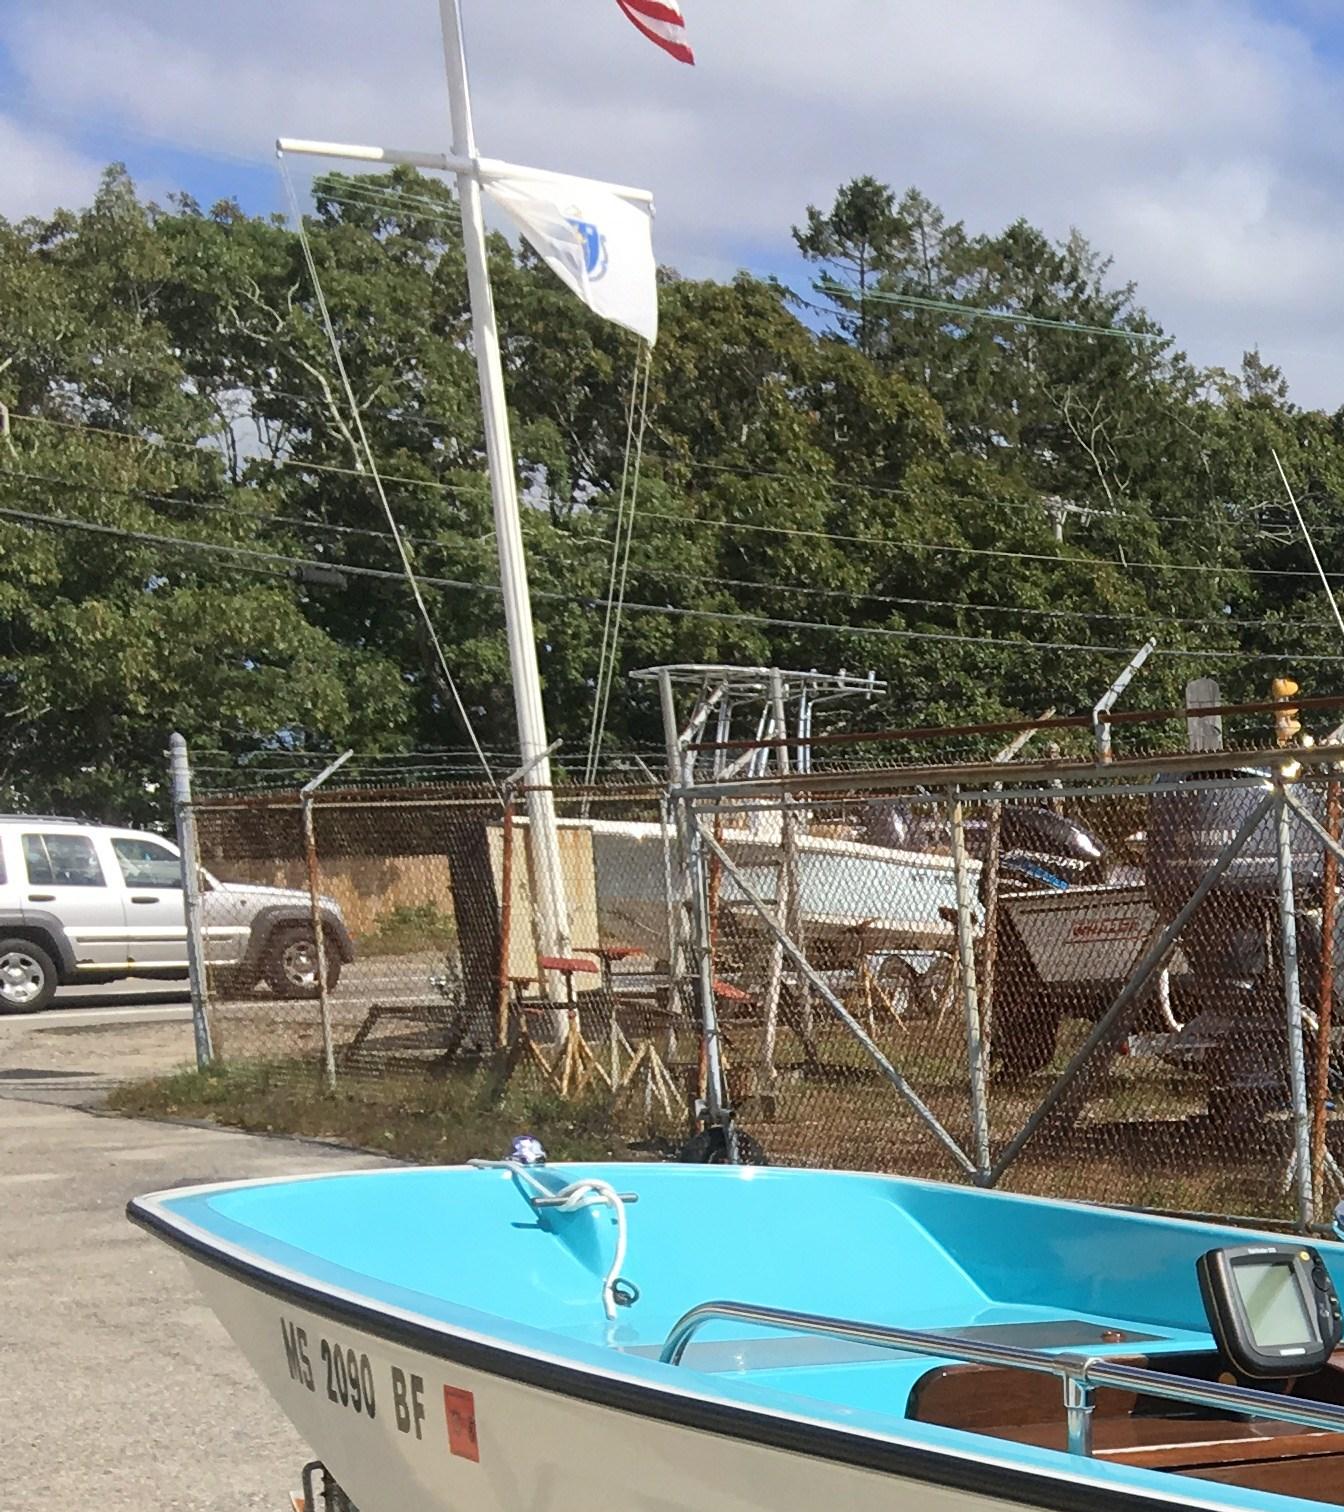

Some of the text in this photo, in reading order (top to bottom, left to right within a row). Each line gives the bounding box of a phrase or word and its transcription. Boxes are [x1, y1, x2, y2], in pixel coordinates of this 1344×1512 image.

[280, 1316, 316, 1393] MS
[320, 1338, 376, 1420] 2090
[391, 1365, 426, 1441] BF
